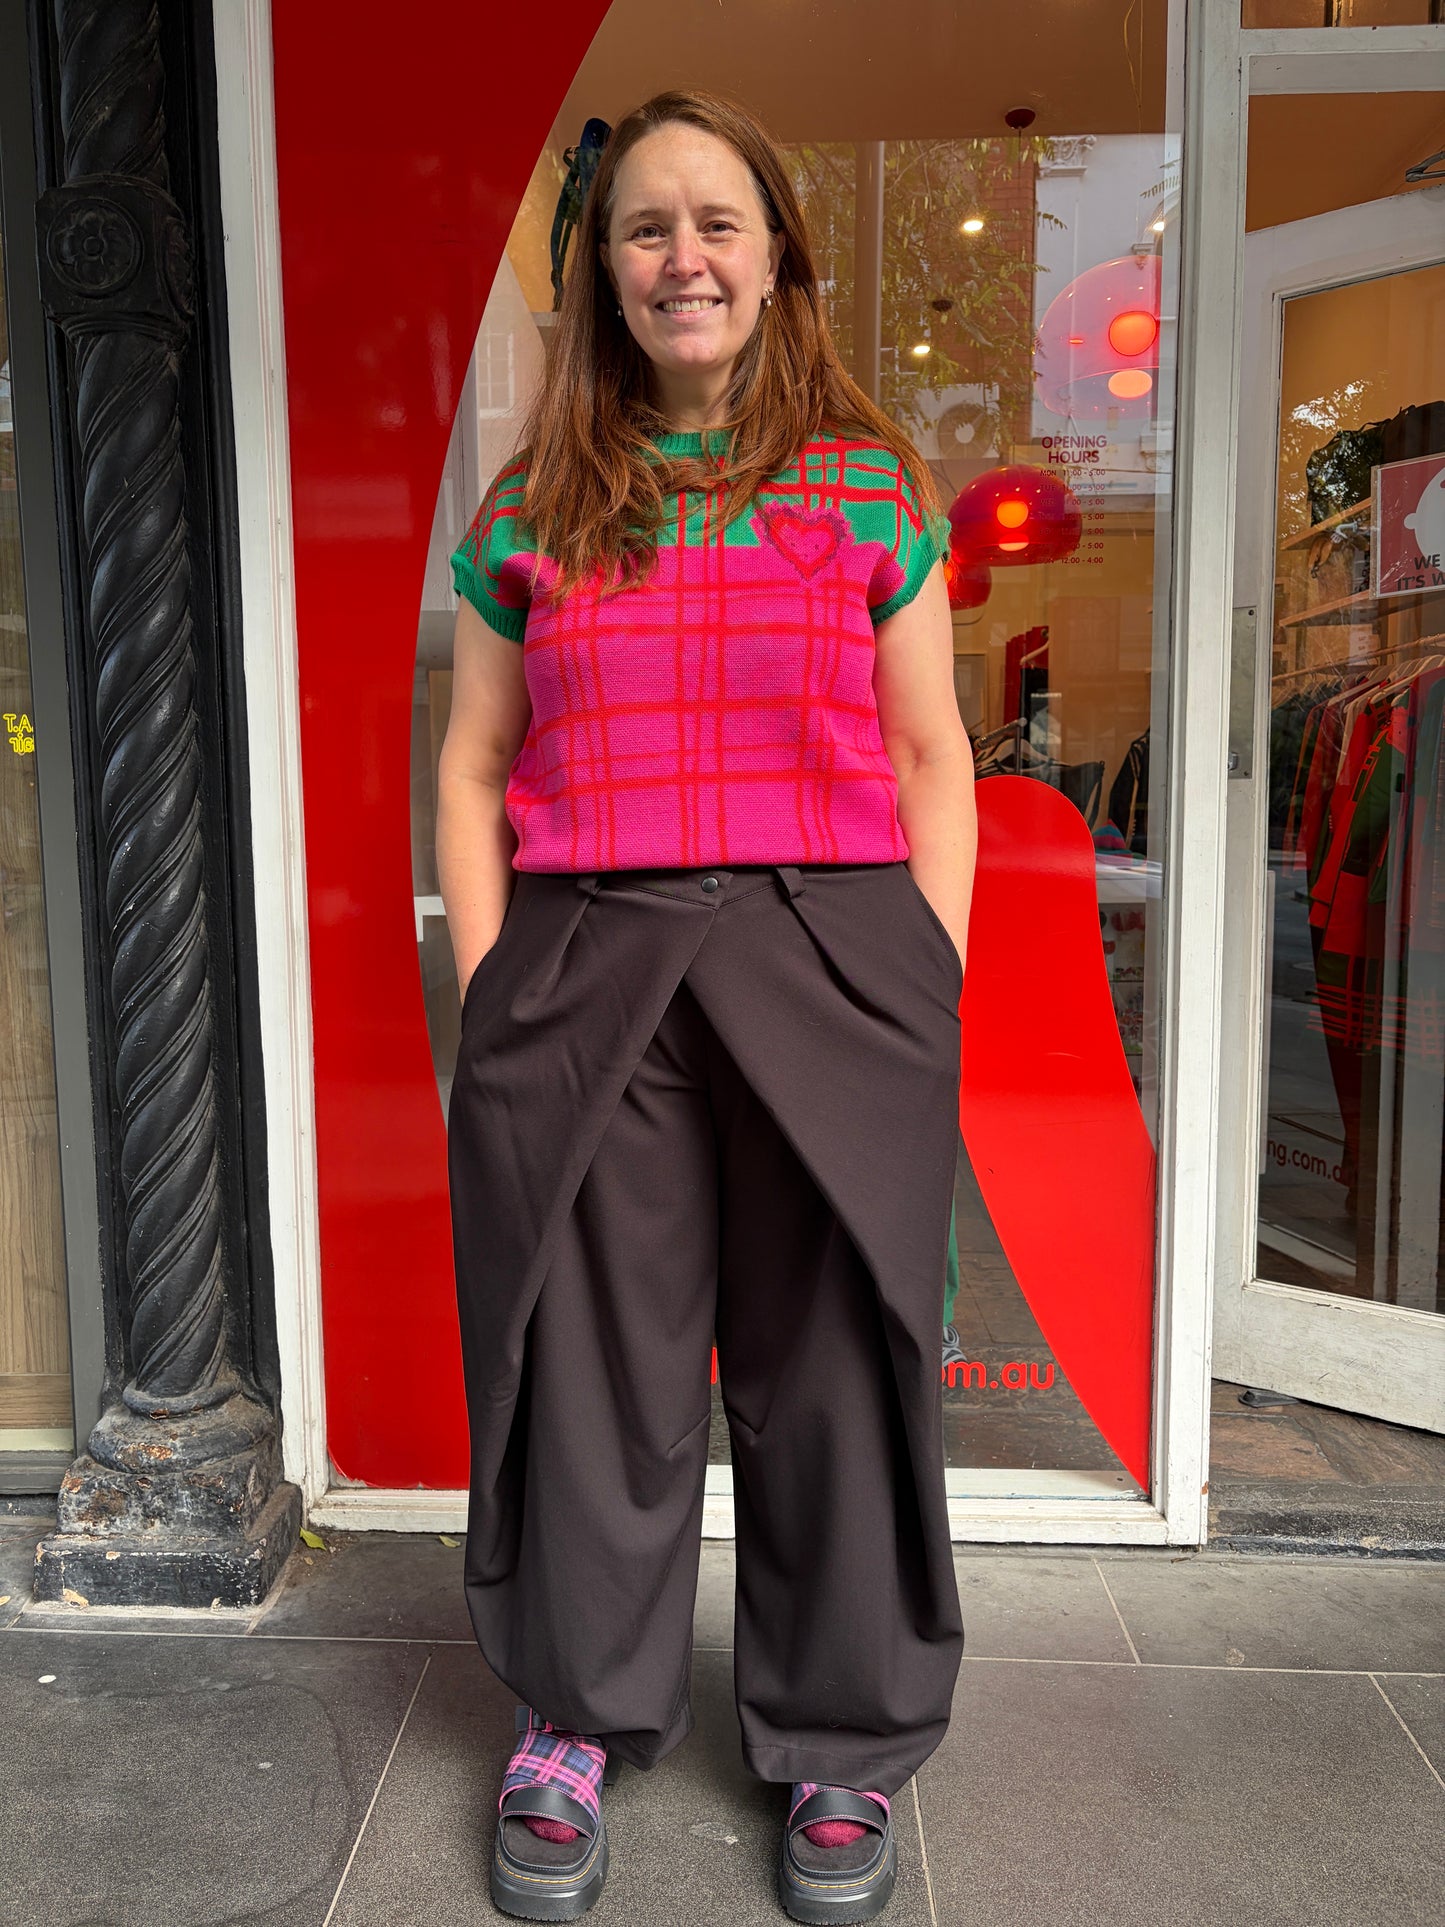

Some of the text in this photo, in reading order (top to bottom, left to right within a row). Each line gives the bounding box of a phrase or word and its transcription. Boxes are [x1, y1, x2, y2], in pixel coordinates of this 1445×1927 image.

[1041, 435, 1107, 449] OPENING
[1048, 450, 1100, 464] HOURS
[1040, 469, 1057, 477] MON
[1088, 469, 1106, 477] 5:00
[1087, 513, 1105, 521] 5:00
[1087, 542, 1104, 550] 5:00
[1414, 554, 1441, 570] WE
[1397, 574, 1426, 591] IT'S
[1267, 1140, 1344, 1183] ng.com.a
[941, 1361, 1055, 1390] m.au
